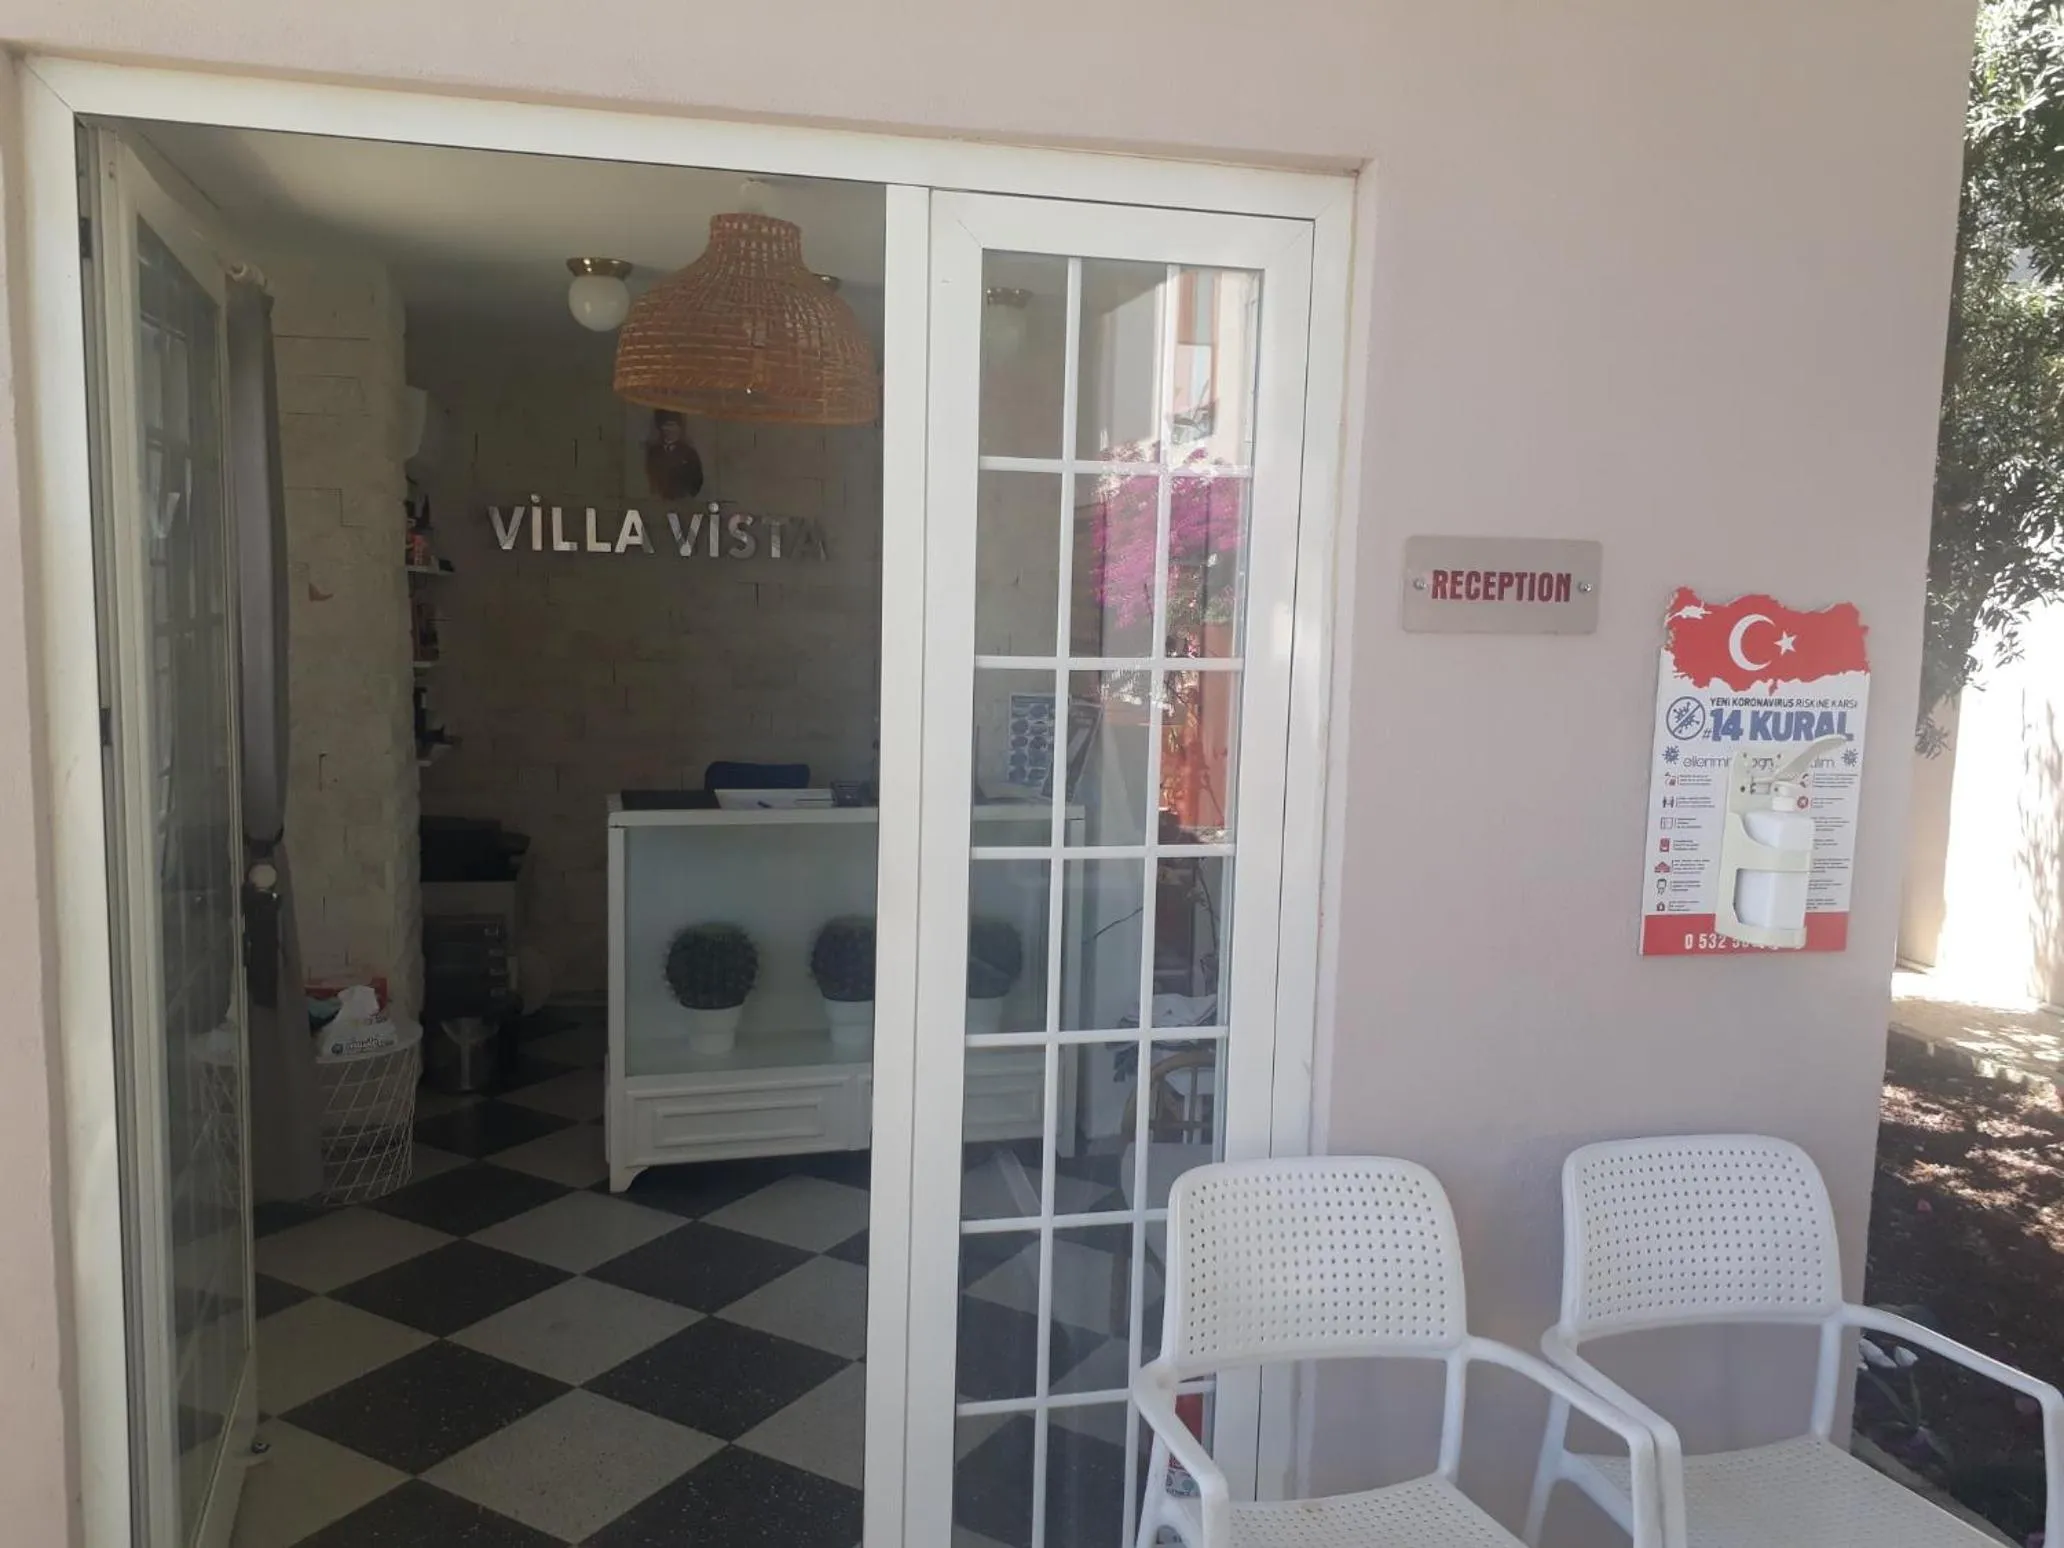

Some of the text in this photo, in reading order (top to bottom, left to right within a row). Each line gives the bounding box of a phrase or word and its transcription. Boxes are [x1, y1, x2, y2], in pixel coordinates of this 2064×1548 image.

[488, 494, 655, 553] VİLLA
[1431, 569, 1572, 603] RECEPTION
[1750, 710, 1854, 742] KURAL
[1685, 933, 1694, 950] 0
[1699, 932, 1726, 949] 532
